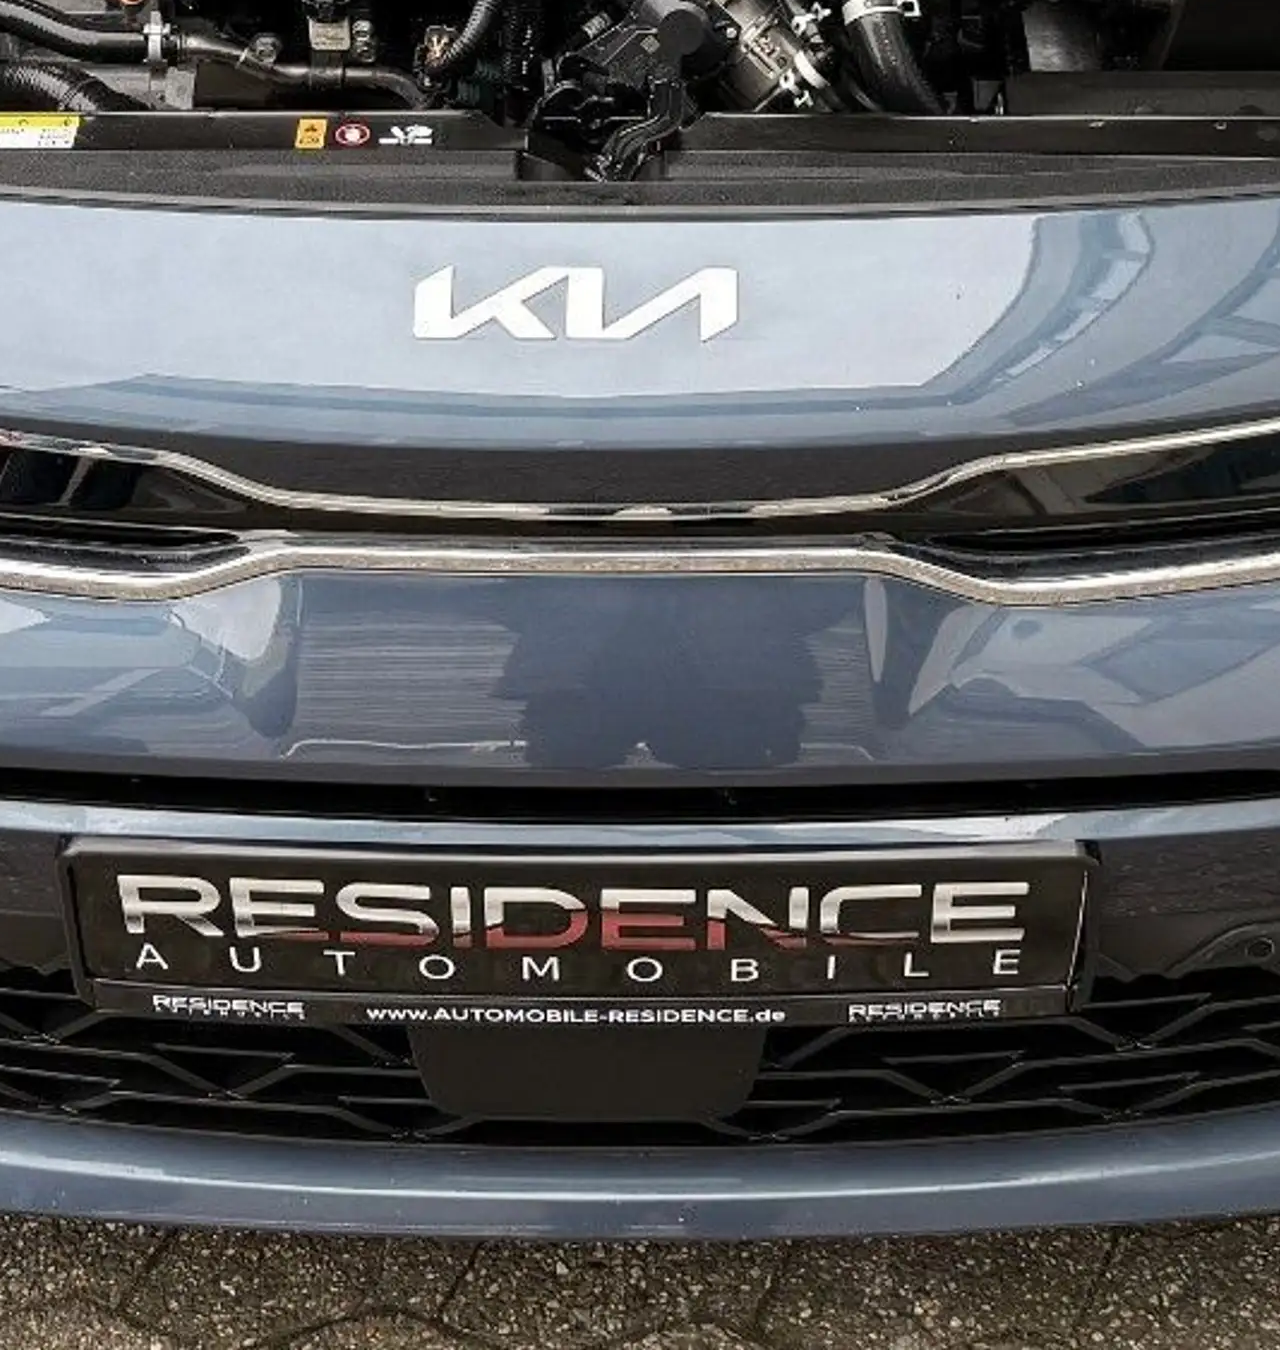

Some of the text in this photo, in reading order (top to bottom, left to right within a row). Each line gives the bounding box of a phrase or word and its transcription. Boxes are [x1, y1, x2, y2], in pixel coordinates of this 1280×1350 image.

[413, 264, 738, 343] KIA
[117, 875, 1030, 950] RESIDENCE
[135, 949, 1022, 983] AUTOMOBILE
[152, 994, 305, 1014] RESIDENCE
[366, 1006, 787, 1023] www.AUTOMOBILE-RESIDENCE.de
[848, 1000, 1002, 1017] RESIDENCE
